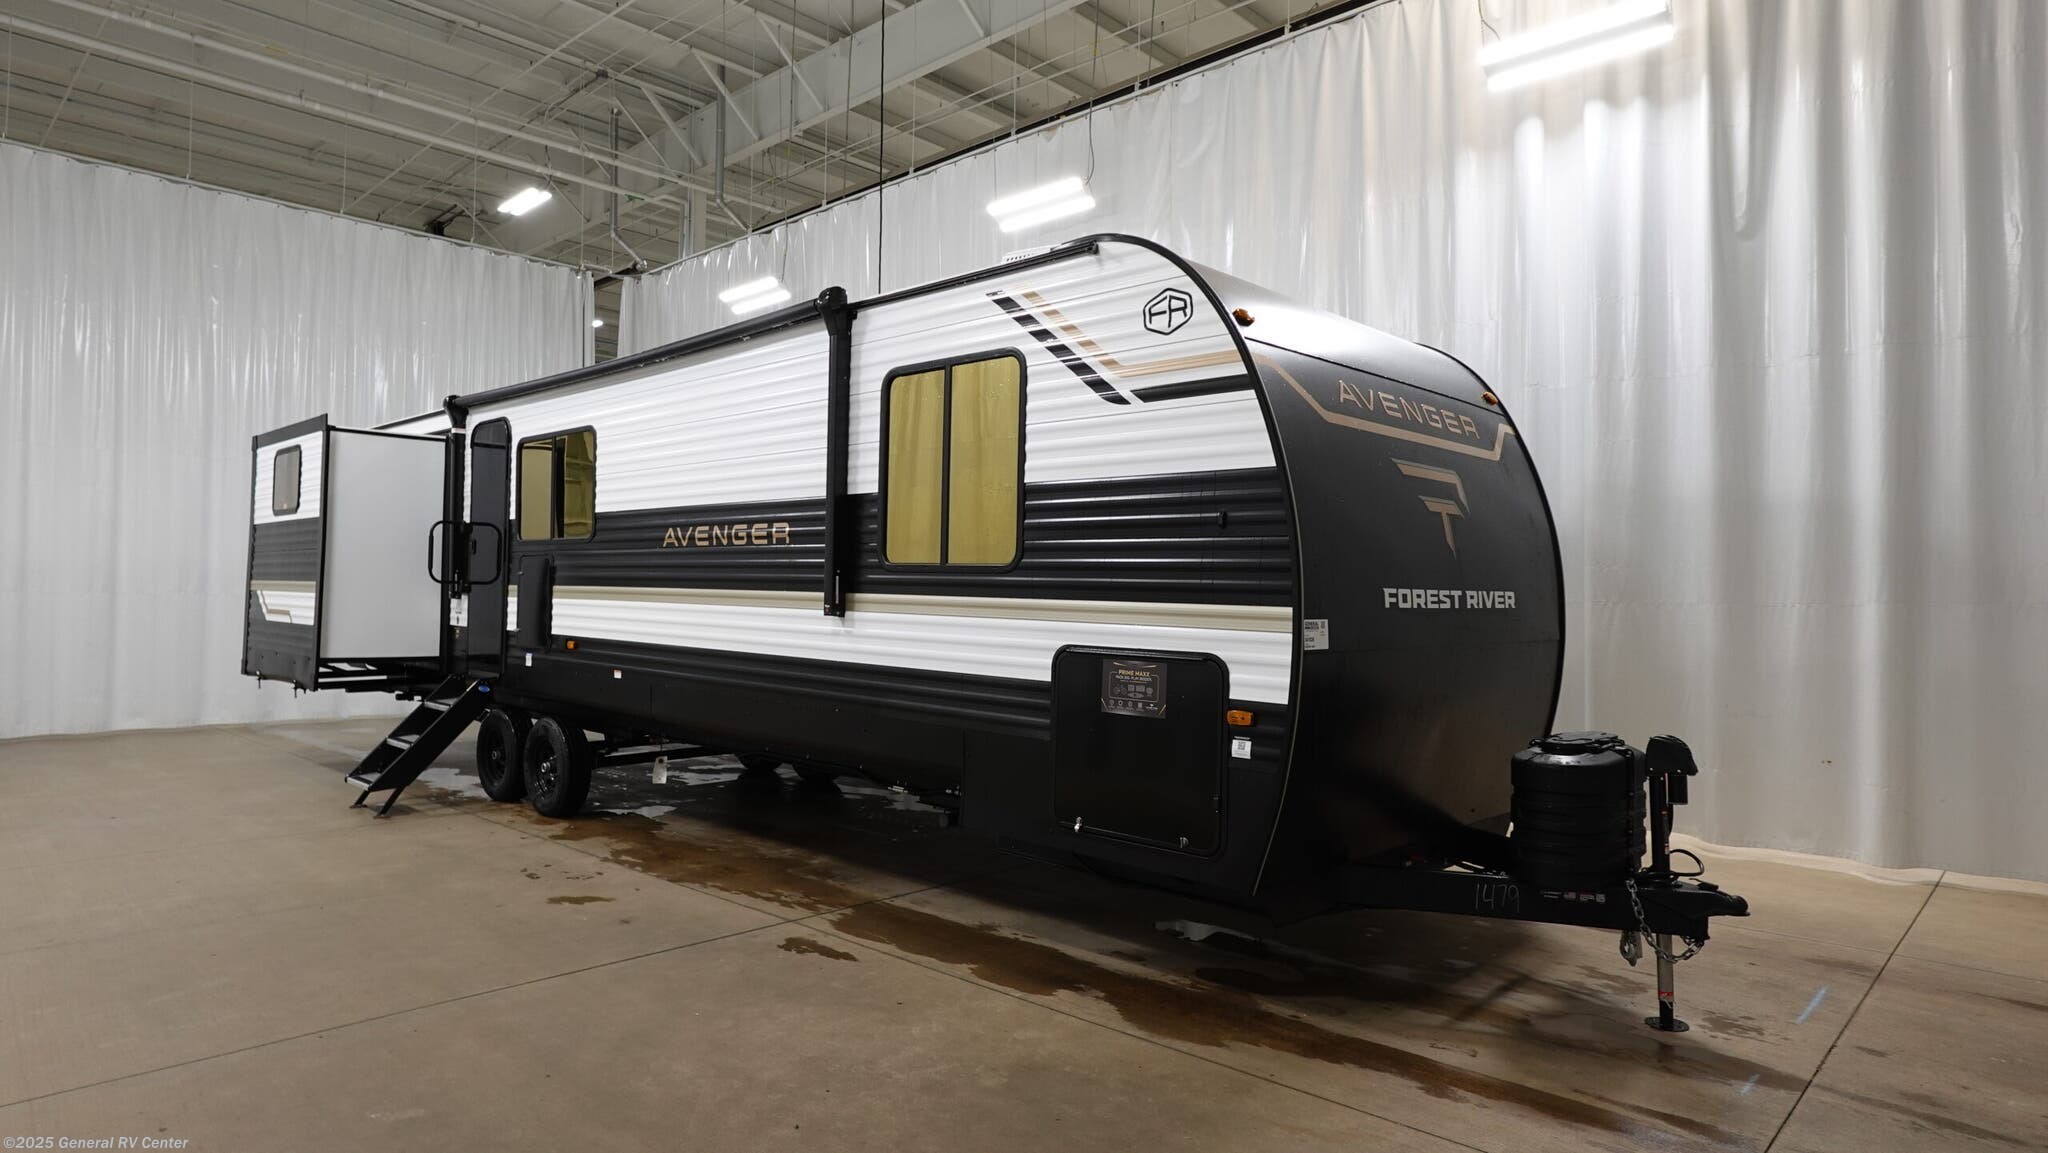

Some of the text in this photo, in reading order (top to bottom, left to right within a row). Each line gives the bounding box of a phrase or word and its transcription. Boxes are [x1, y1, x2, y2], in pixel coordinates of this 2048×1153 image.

[1337, 379, 1480, 440] AVENGER
[662, 522, 790, 547] AVENGER
[1383, 587, 1516, 609] FOREST RIVER
[1475, 883, 1520, 914] 1479
